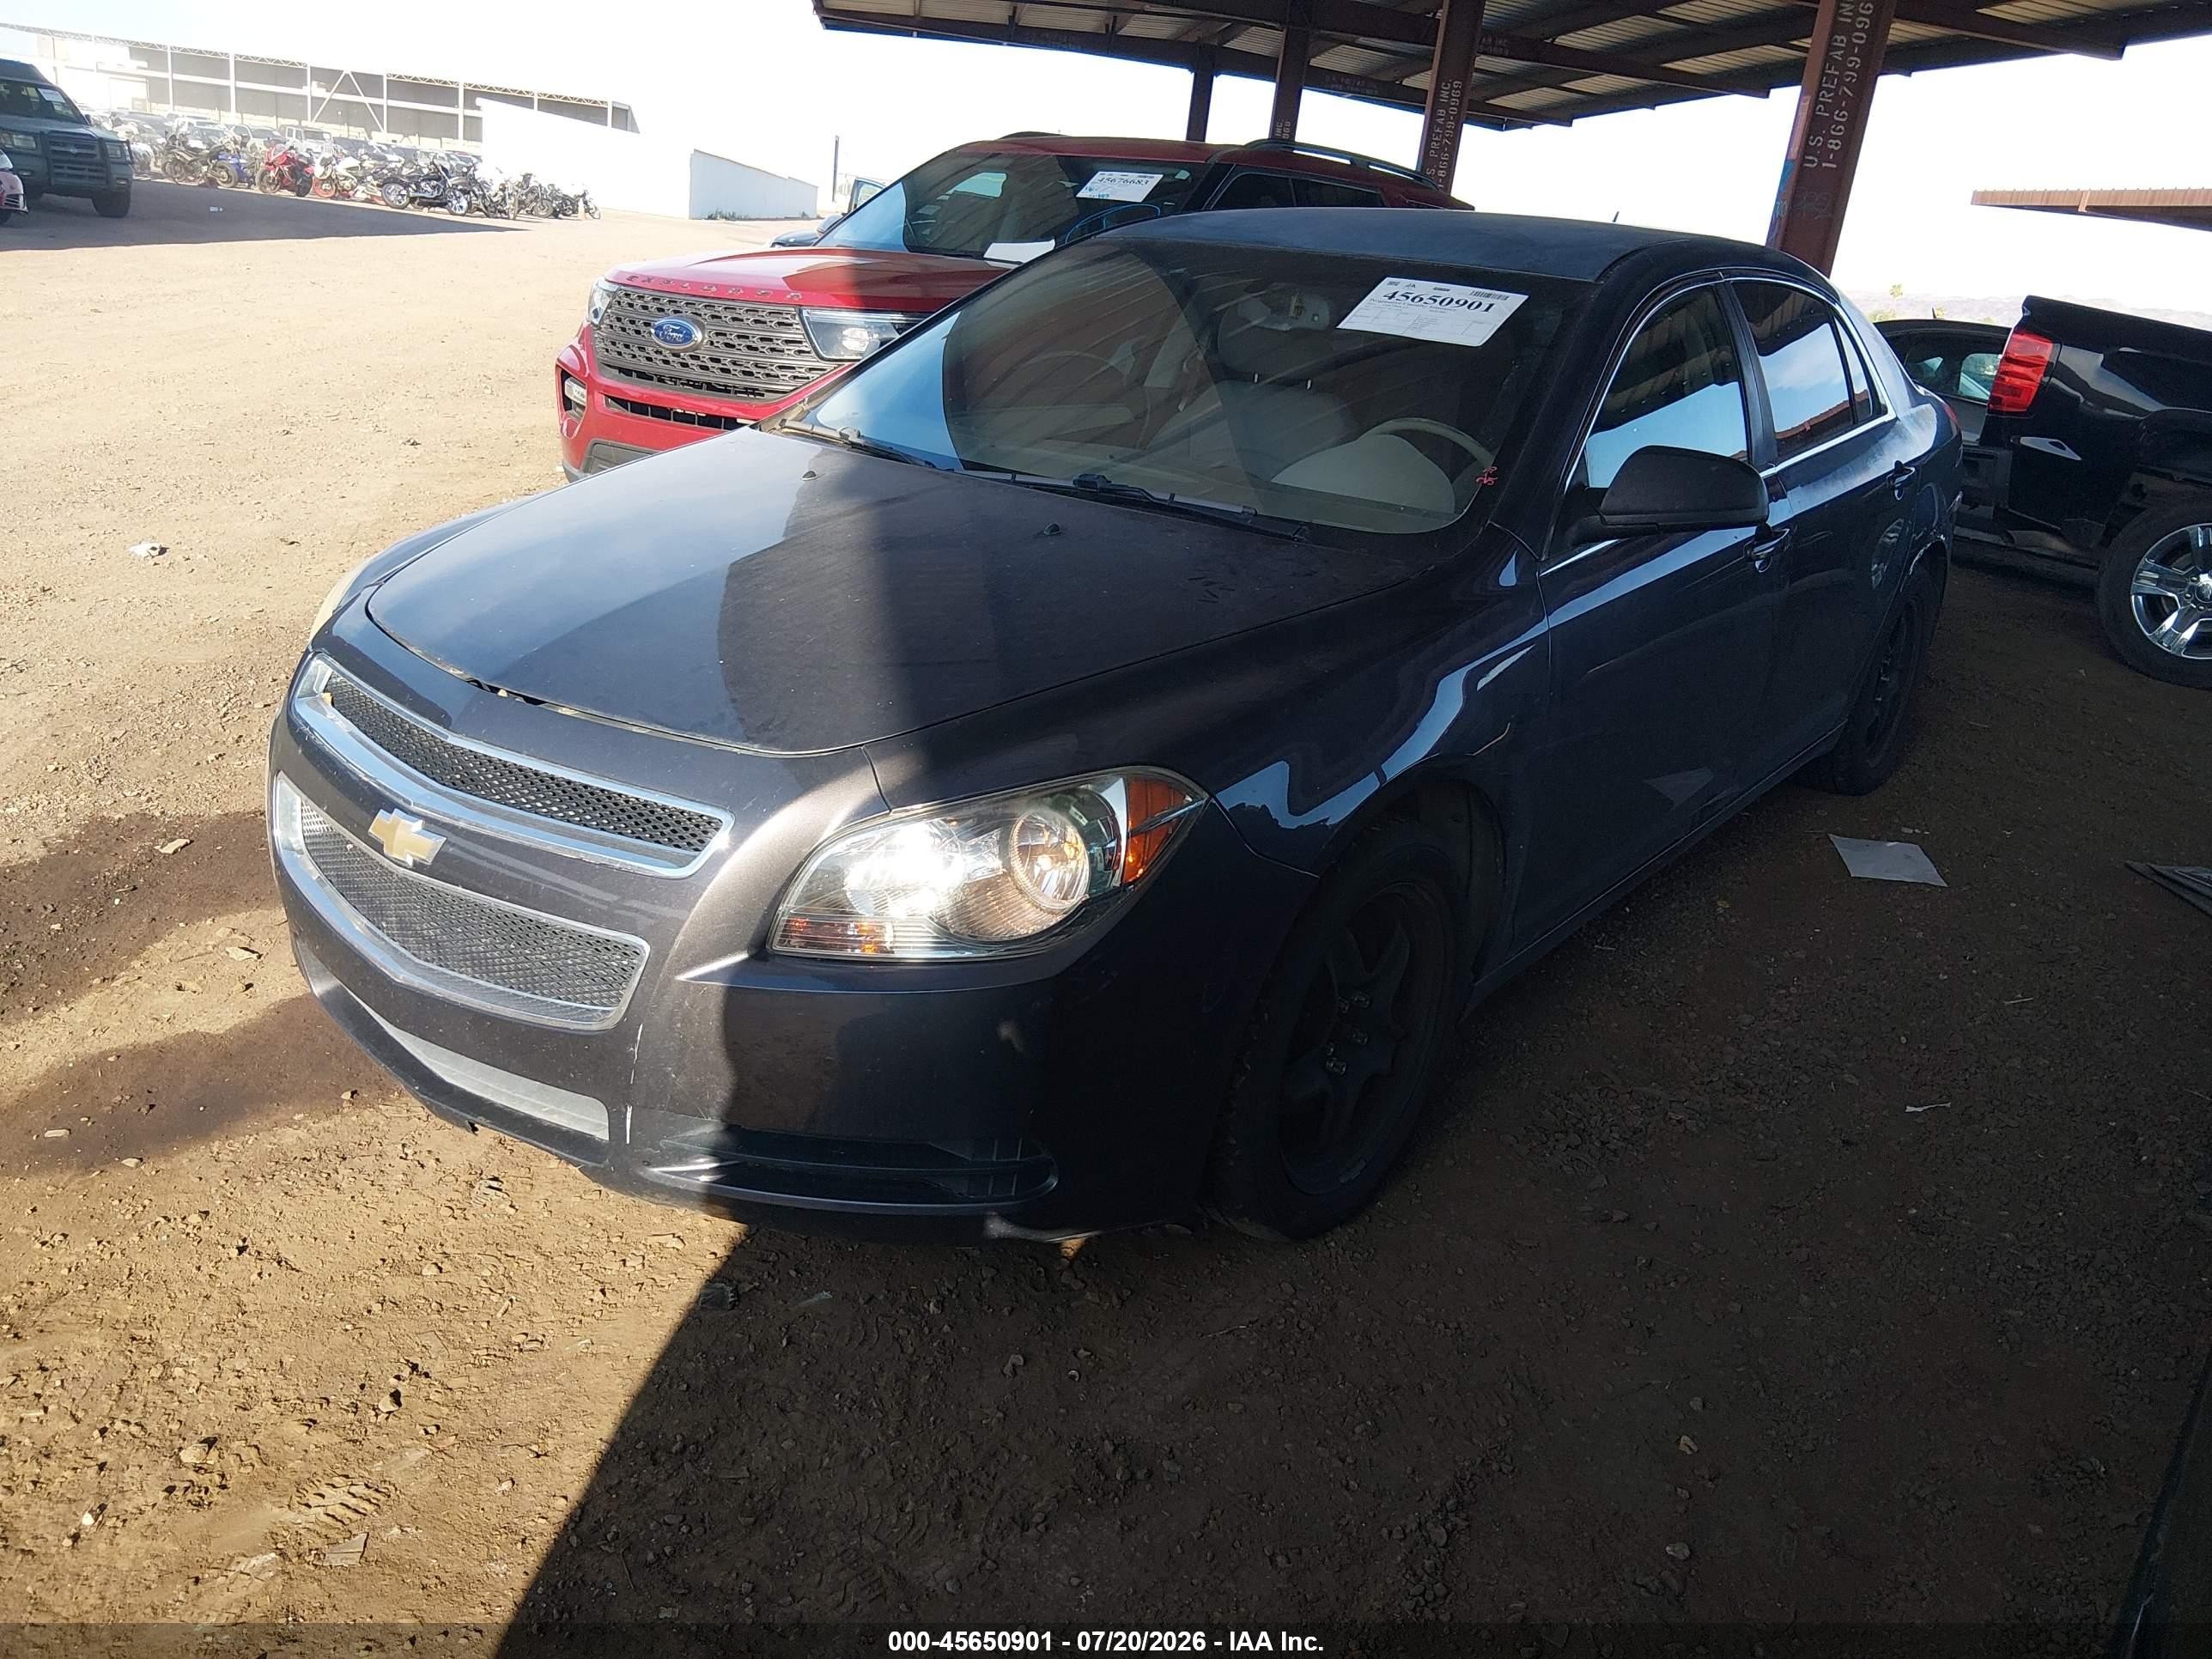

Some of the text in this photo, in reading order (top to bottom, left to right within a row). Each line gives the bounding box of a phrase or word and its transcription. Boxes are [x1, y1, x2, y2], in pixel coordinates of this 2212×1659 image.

[1802, 0, 1856, 169] U.S. PREFAB IN
[1428, 108, 1447, 158] PREFAB
[1439, 79, 1454, 103] INC.
[1382, 290, 1496, 313] 45650901
[659, 324, 686, 342] Ford
